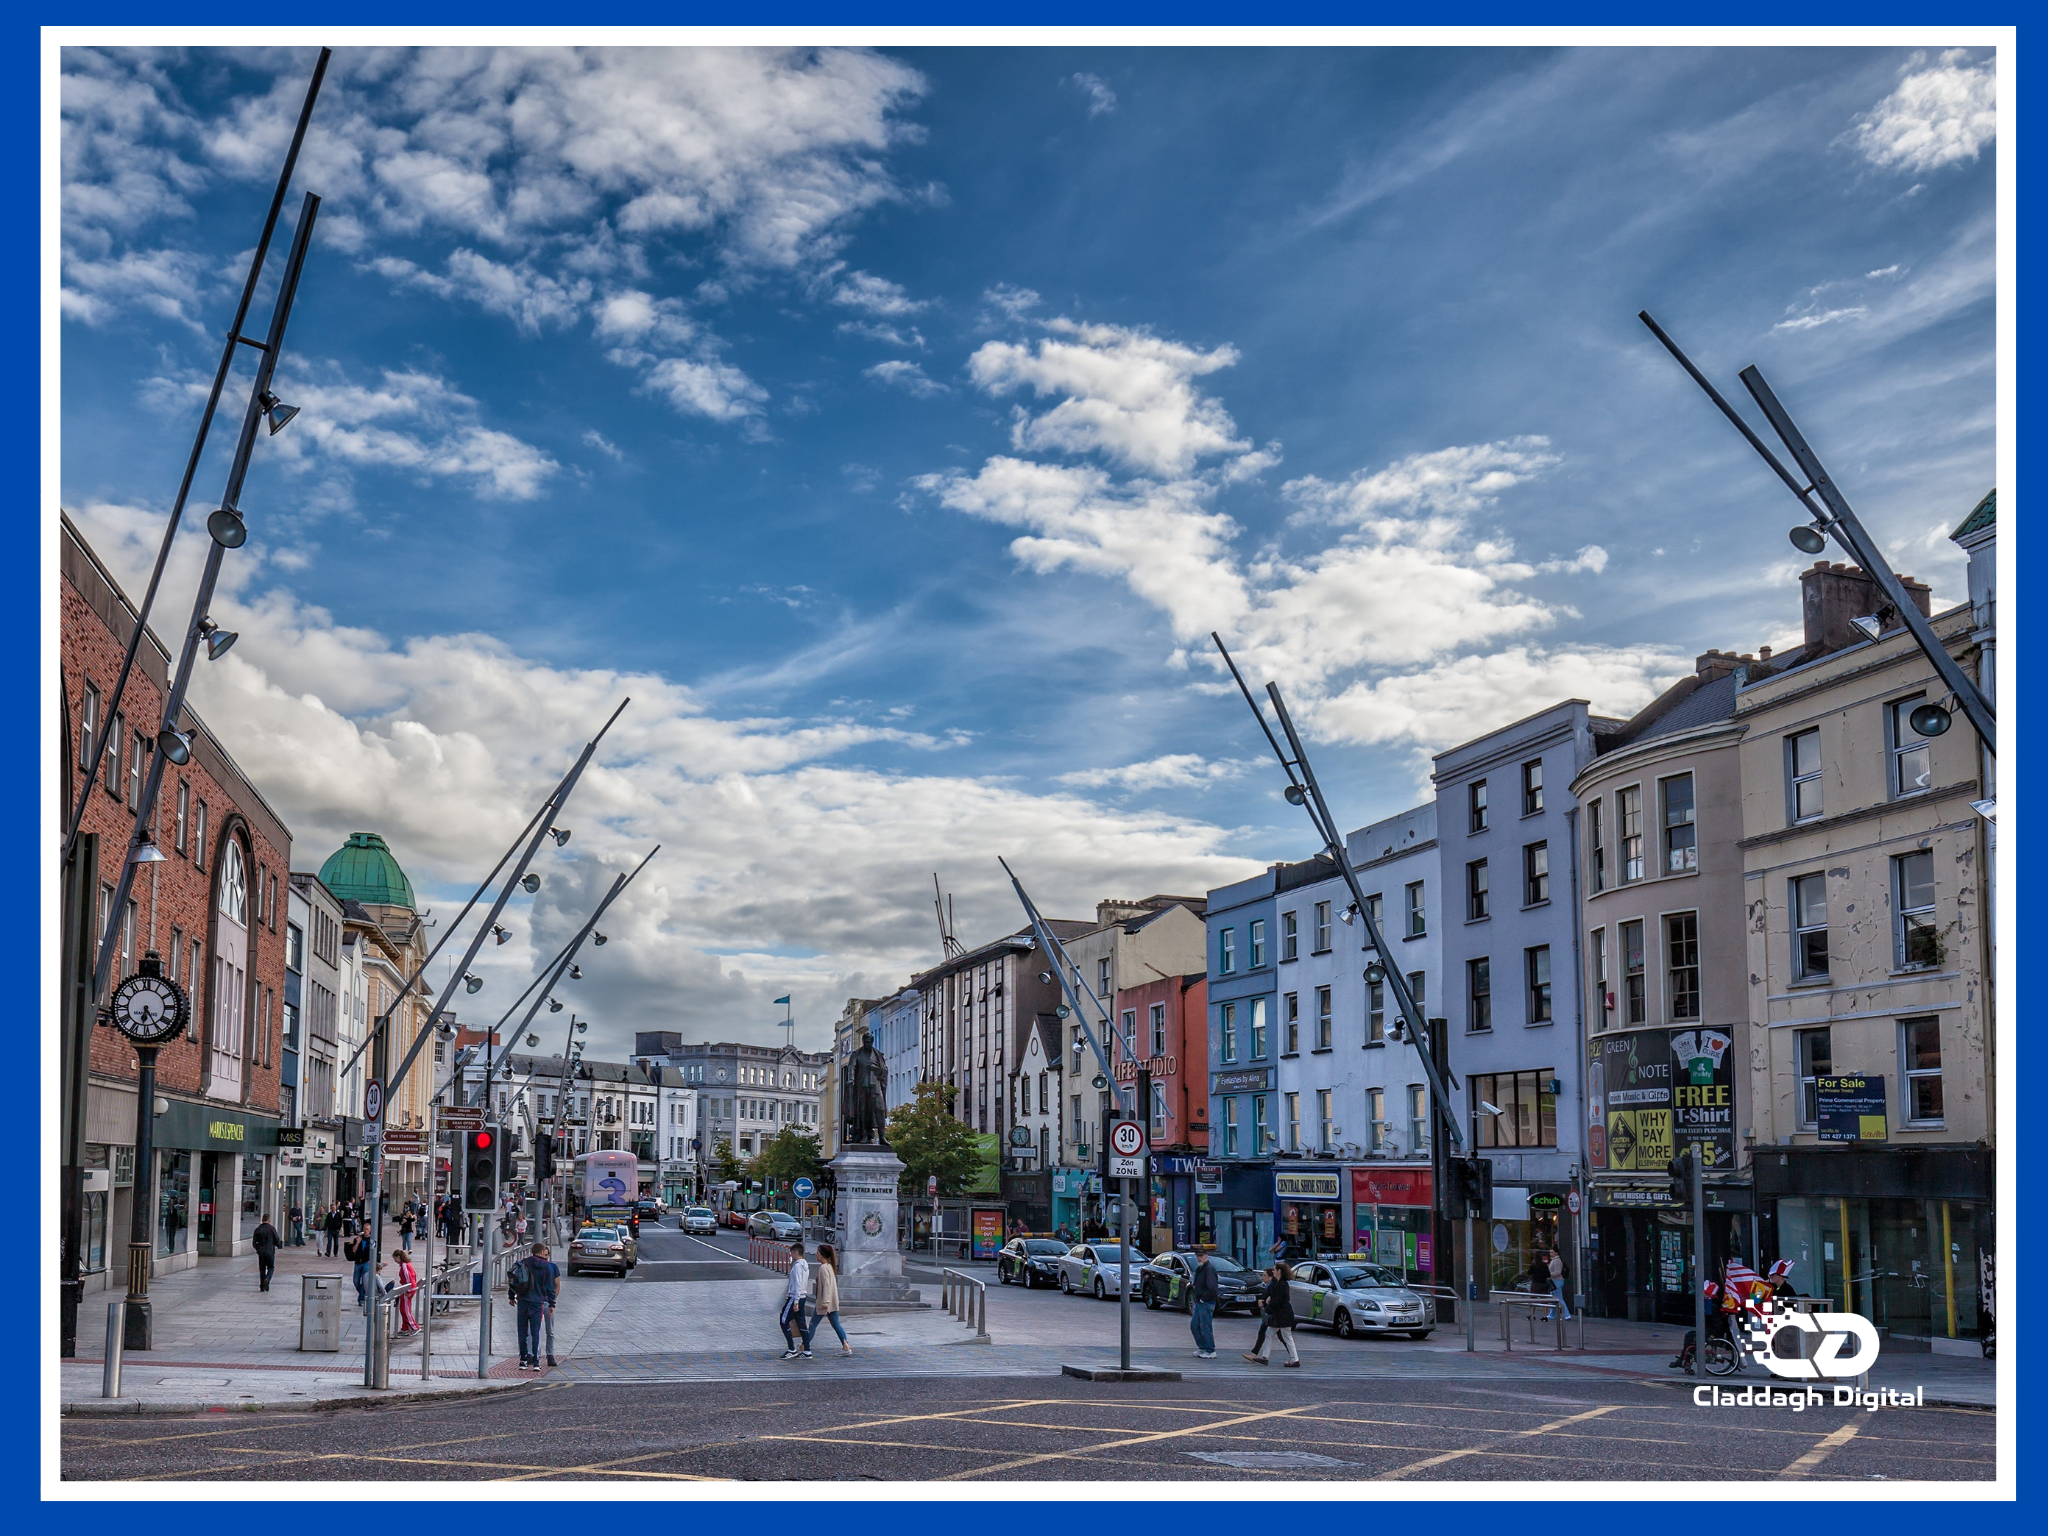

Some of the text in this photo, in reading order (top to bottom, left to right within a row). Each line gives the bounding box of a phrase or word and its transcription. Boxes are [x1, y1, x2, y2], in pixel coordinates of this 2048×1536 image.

[1607, 1040, 1630, 1053] GREEN
[1638, 1064, 1669, 1078] NOTE
[1221, 1076, 1242, 1086] Eyelashes
[1818, 1078, 1866, 1088] For Sale
[370, 1088, 378, 1105] 30
[1622, 1092, 1640, 1101] Music
[1642, 1091, 1646, 1100] &
[1648, 1090, 1669, 1101] Gifts
[1675, 1085, 1730, 1107] FREE
[1640, 1112, 1667, 1126] WHY
[1675, 1107, 1731, 1123] T-Shirt
[280, 1132, 301, 1142] M&S
[1120, 1128, 1135, 1142] 30
[1642, 1129, 1664, 1143] PAY
[1861, 1130, 1885, 1138] savills
[1638, 1145, 1671, 1159] MORE
[1714, 1146, 1723, 1155] OR
[1714, 1151, 1731, 1165] MORE
[1116, 1167, 1138, 1175] ZONE
[1277, 1179, 1337, 1194] CENTRAL SHOE STORES
[1533, 1196, 1560, 1204] schuh
[1627, 1192, 1645, 1200] MUSIC
[1653, 1193, 1673, 1201] GIFTS
